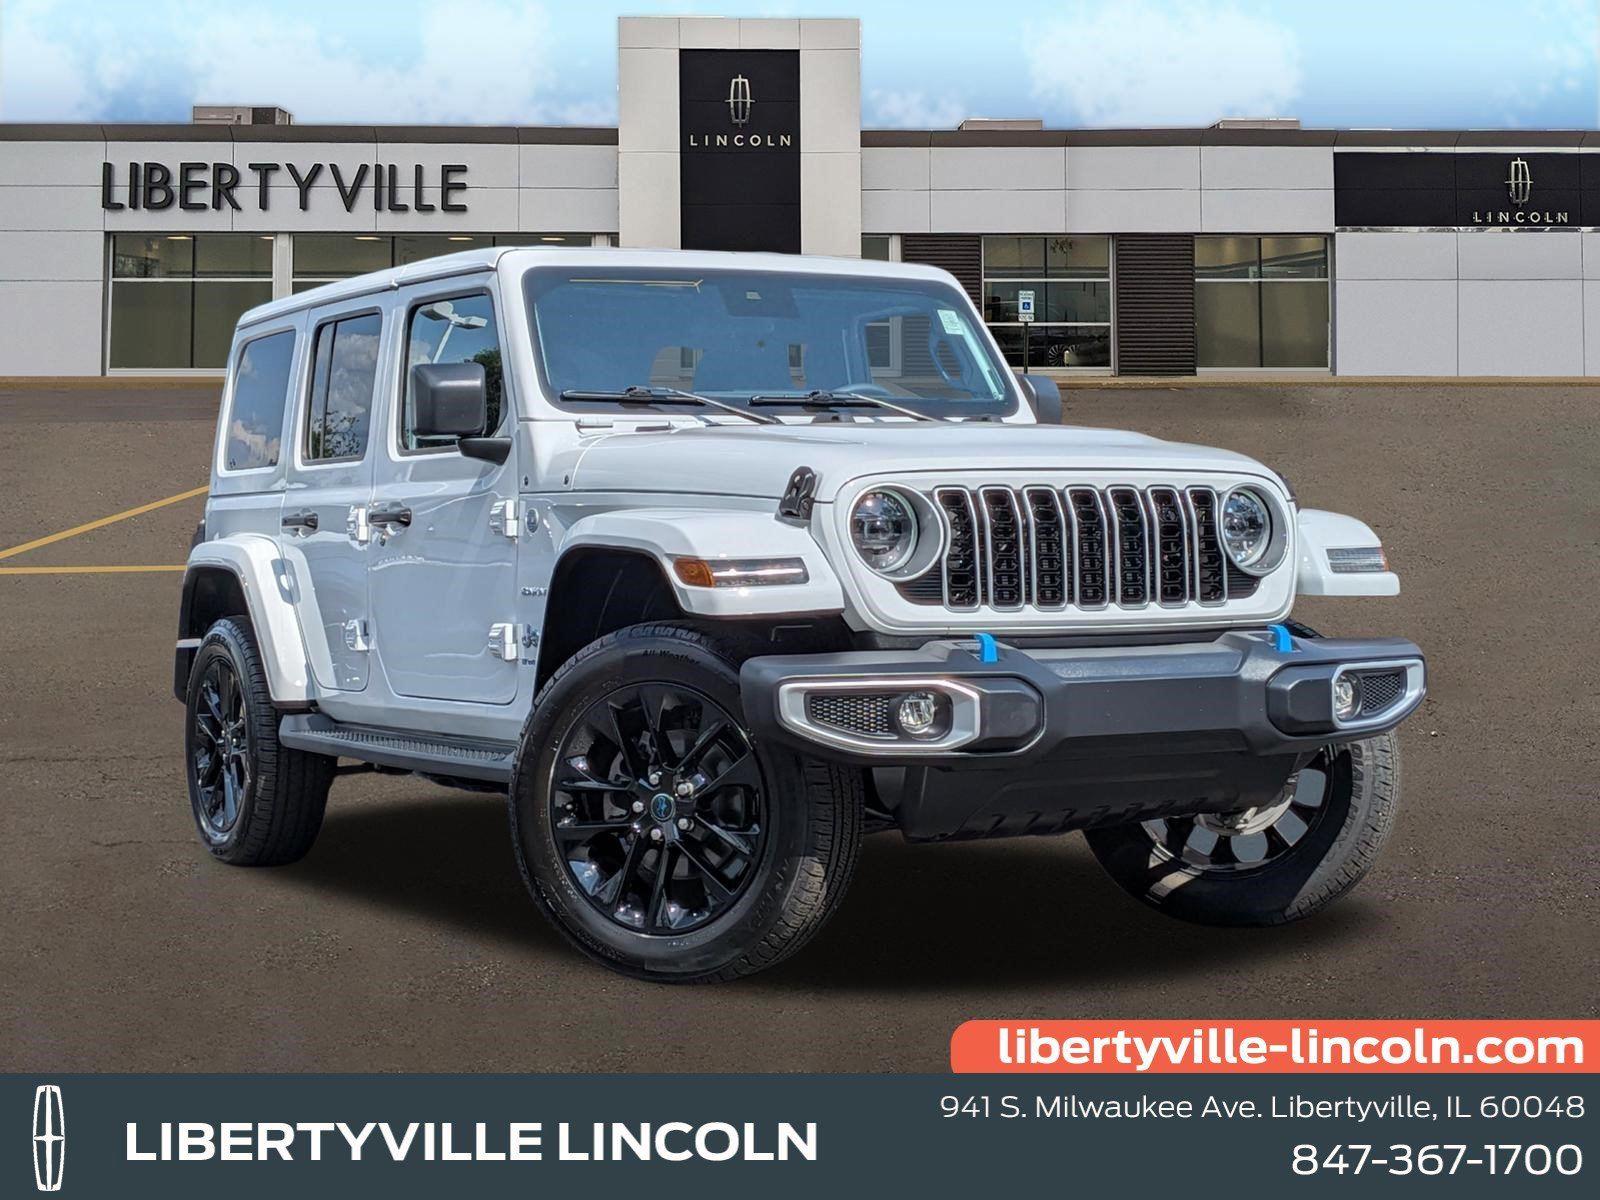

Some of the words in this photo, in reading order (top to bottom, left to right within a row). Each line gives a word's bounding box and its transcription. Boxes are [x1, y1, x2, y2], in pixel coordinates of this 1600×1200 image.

[690, 134, 791, 147] LINCOLN
[102, 162, 468, 212] LIBERTYVILLE
[1473, 211, 1568, 223] LINCOLN
